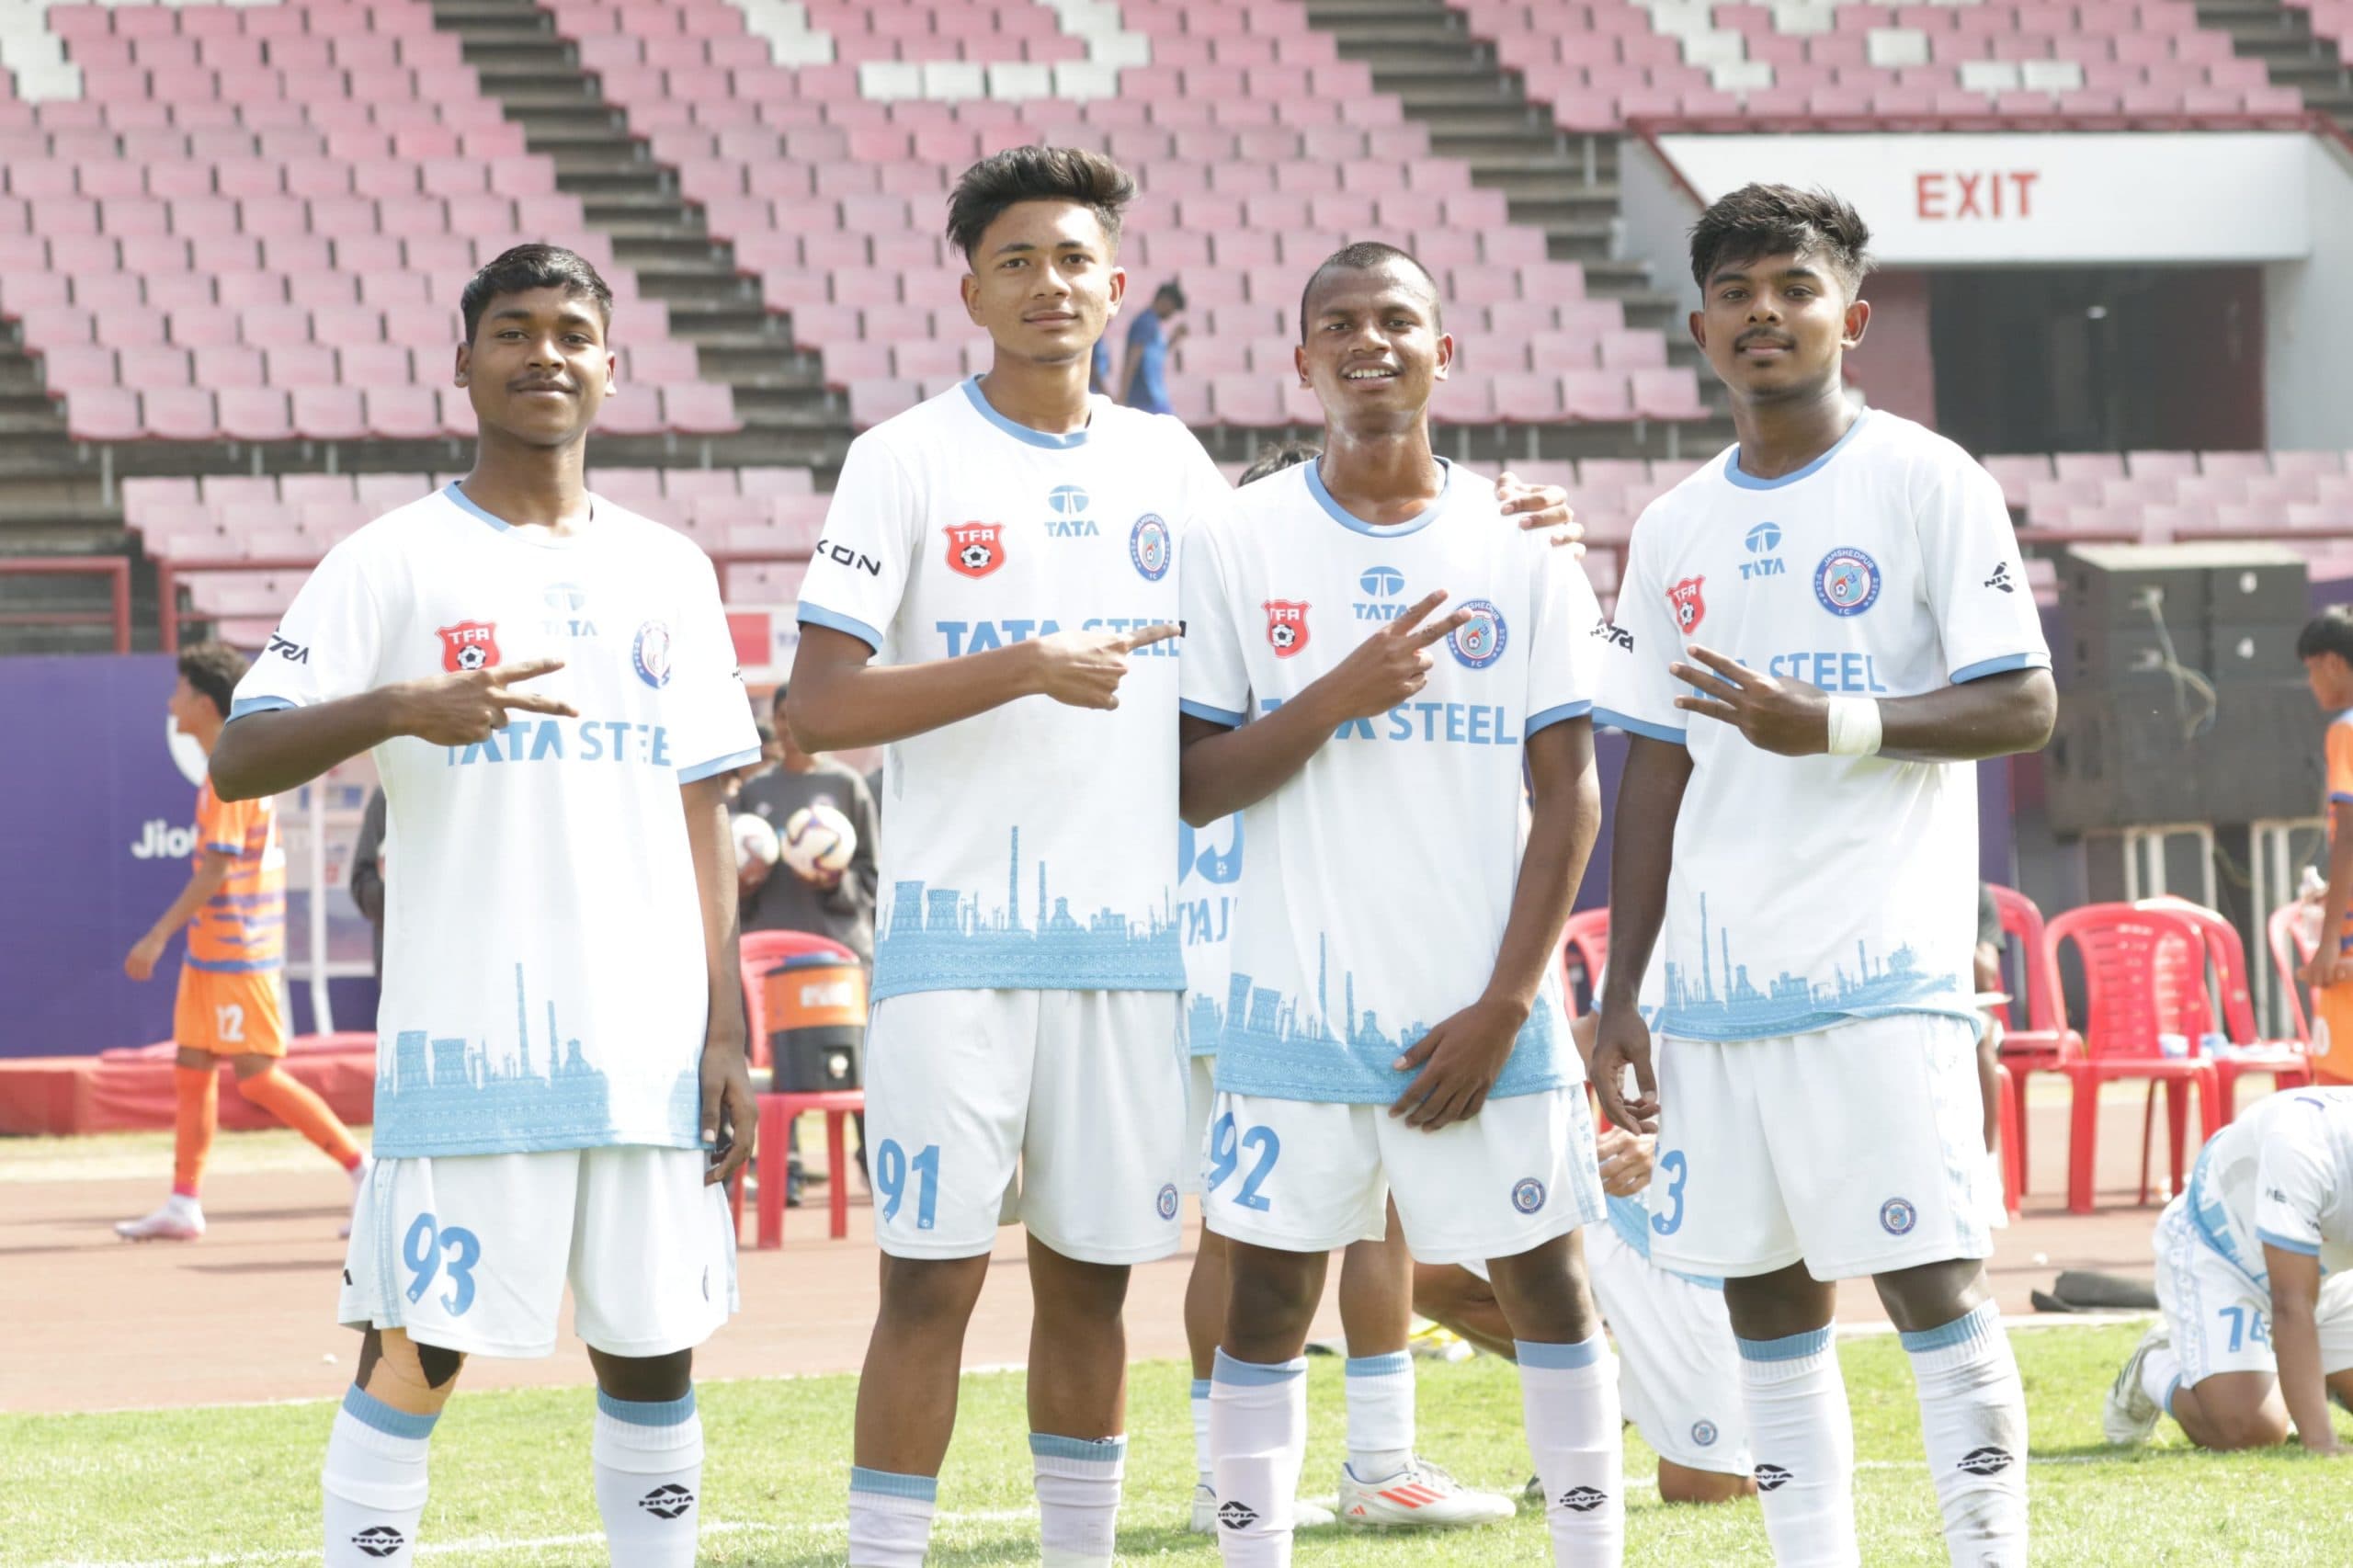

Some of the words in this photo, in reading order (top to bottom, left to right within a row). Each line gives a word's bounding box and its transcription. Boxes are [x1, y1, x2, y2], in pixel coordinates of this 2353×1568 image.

[1915, 172, 2039, 219] EXIT
[953, 528, 995, 543] TFA
[1044, 520, 1100, 538] TATA
[1738, 558, 1787, 581] TATA
[1824, 550, 1875, 569] JAMSHEDPUR
[449, 628, 490, 643] TFA
[1769, 652, 1887, 693] STEEL
[1388, 702, 1518, 745] STEEL
[130, 820, 199, 858] Jio
[215, 1004, 244, 1042] 12
[1207, 1111, 1280, 1212] 92
[877, 1138, 939, 1230] 91
[1651, 1142, 1688, 1235] 3
[403, 1212, 481, 1317] 93
[1956, 1456, 2015, 1468] NIVIA
[639, 1495, 694, 1507] NIVIA
[1558, 1494, 1608, 1504] NIVIA
[351, 1537, 404, 1545] NIVIA
